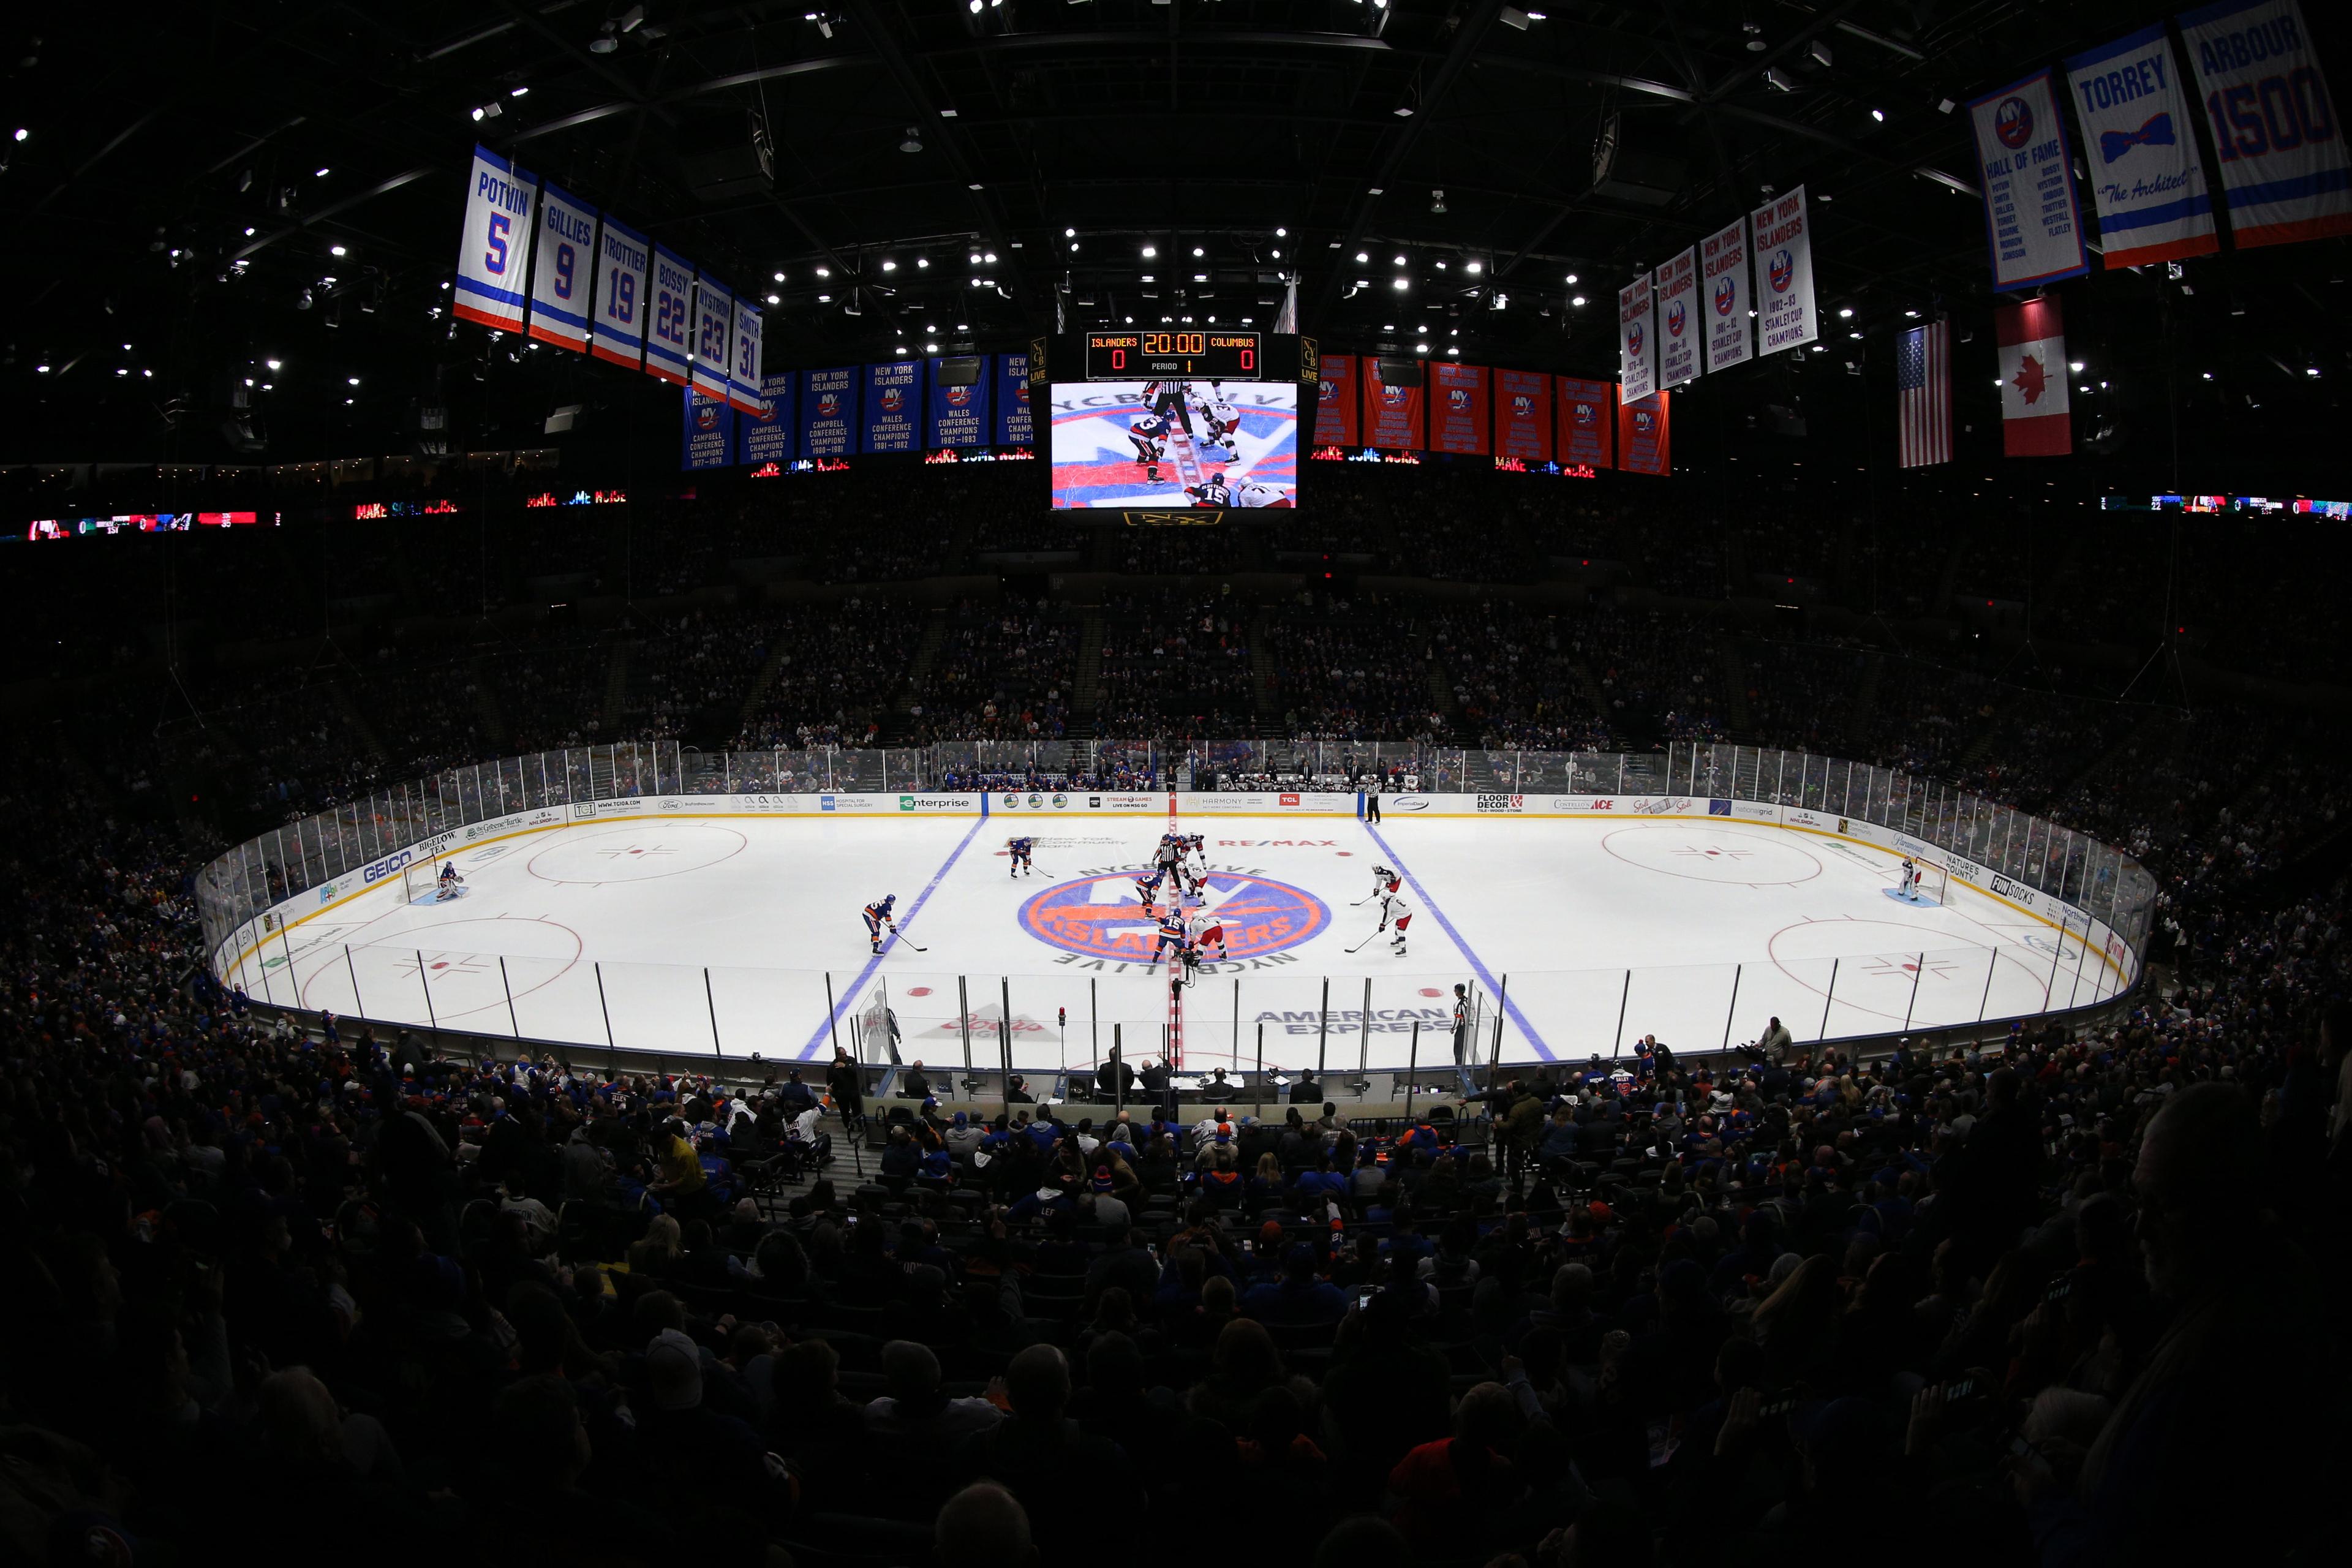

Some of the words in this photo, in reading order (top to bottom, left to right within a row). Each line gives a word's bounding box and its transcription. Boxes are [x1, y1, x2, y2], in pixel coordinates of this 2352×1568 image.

[2199, 14, 2302, 76] ARBOUR
[2080, 53, 2169, 113] TORREY
[2206, 66, 2334, 163] 1500
[1986, 157, 2012, 180] HALL
[2015, 151, 2027, 170] OF
[2032, 139, 2060, 165] FAME
[2042, 163, 2060, 177] BOSSY
[1992, 181, 2010, 193] POTVIN
[2037, 175, 2063, 191] NYSTROM
[478, 172, 528, 217] POTVIN
[1994, 192, 2010, 204] SMITH
[2043, 187, 2065, 202] ARBOUR
[1757, 210, 1774, 230] NEW
[1776, 193, 1800, 221] YORK
[1996, 203, 2015, 216] GILLIES
[2042, 199, 2067, 214] TROTTIER
[548, 206, 590, 246] GILLIES
[1997, 214, 2016, 227] TORREY
[2042, 211, 2069, 226] WESTFALL
[1757, 217, 1803, 252] ISLANDERS
[2048, 223, 2071, 238] FLATLEY
[485, 212, 511, 276] 5
[1705, 240, 1719, 258] NEW
[1722, 225, 1741, 248] YORK
[604, 233, 646, 274] TROTTIER
[1660, 265, 1673, 283] NEW
[1675, 253, 1691, 274] YORK
[1706, 247, 1742, 279] ISLANDERS
[554, 243, 575, 300] 9
[660, 263, 688, 292] BOSSY
[608, 268, 636, 323] 19
[1622, 290, 1633, 306] NEW
[1635, 280, 1649, 297] YORK
[1660, 274, 1692, 302] ISLANDERS
[699, 291, 730, 320] NYSTROM
[1621, 299, 1649, 324] ISLANDERS
[657, 290, 685, 345] 22
[1765, 312, 1789, 331] STANLEY
[1790, 307, 1803, 322] CUP
[739, 312, 759, 339] SMITH
[701, 314, 725, 364] 23
[1091, 338, 1137, 347] ISLANDERS
[1145, 334, 1202, 353] 20:00
[1211, 337, 1254, 347] COLUMBUS
[1712, 333, 1730, 351] STANLEY
[1732, 330, 1742, 342] CUP
[1768, 325, 1803, 347] CHAMPIONS
[739, 337, 756, 380] 31
[1009, 358, 1026, 366] NEW
[1113, 350, 1125, 369] 0
[1241, 350, 1253, 369] 0
[1665, 354, 1682, 369] STANLEY
[1683, 350, 1692, 362] CUP
[1714, 345, 1742, 366] CHAMPIONS
[875, 367, 891, 375] NEW
[894, 365, 913, 374] YORK
[1188, 360, 1191, 372] 1
[768, 377, 785, 386] YORK
[812, 372, 827, 382] NEW
[831, 371, 848, 380] YORK
[875, 375, 913, 385] ISLANDERS
[1030, 370, 1046, 383] LIVE
[1302, 369, 1317, 380] LIVE
[1625, 371, 1640, 386] STANLEY
[1640, 368, 1649, 380] CUP
[1667, 367, 1692, 382] CHAMPIONS
[812, 381, 848, 391] ISLANDERS
[1627, 382, 1648, 398] CHAMPIONS
[813, 420, 844, 429] CAMPBELL
[872, 423, 911, 432] CONFERENCE
[938, 417, 979, 427] CONFERENCE
[693, 432, 722, 442] CAMPBELL
[752, 425, 782, 435] CAMPBELL
[810, 428, 847, 438] CONFERENCE
[873, 432, 910, 441] CHAMPIONS
[940, 426, 978, 435] CHAMPIONS
[690, 439, 725, 451] CONFERENCE
[748, 433, 785, 443] CONFERENCE
[811, 437, 845, 447] CHAMPIONS
[691, 448, 723, 459] CHAMPIONS
[750, 442, 784, 452] CHAMPIONS
[1494, 456, 1527, 473] MAKE
[1205, 489, 1224, 503] 15
[356, 503, 387, 519] MAKE
[663, 800, 678, 810] Ford
[901, 799, 970, 809] enterprise
[1510, 795, 1523, 808] &
[1590, 798, 1613, 810] ACE
[1633, 799, 1649, 813] Stoli
[483, 821, 504, 833] Greene
[504, 816, 522, 826] Turtle
[419, 831, 456, 851] BIGELOW
[1891, 832, 1926, 854] Paramount
[430, 844, 446, 855] TEA
[364, 850, 412, 883] GEICO
[1993, 877, 2010, 894] FUN
[2009, 884, 2034, 905] SOCKS
[1167, 919, 1179, 929] 15
[1254, 1008, 1447, 1023] AMERICAN
[1287, 1020, 1458, 1035] EXPRESS
